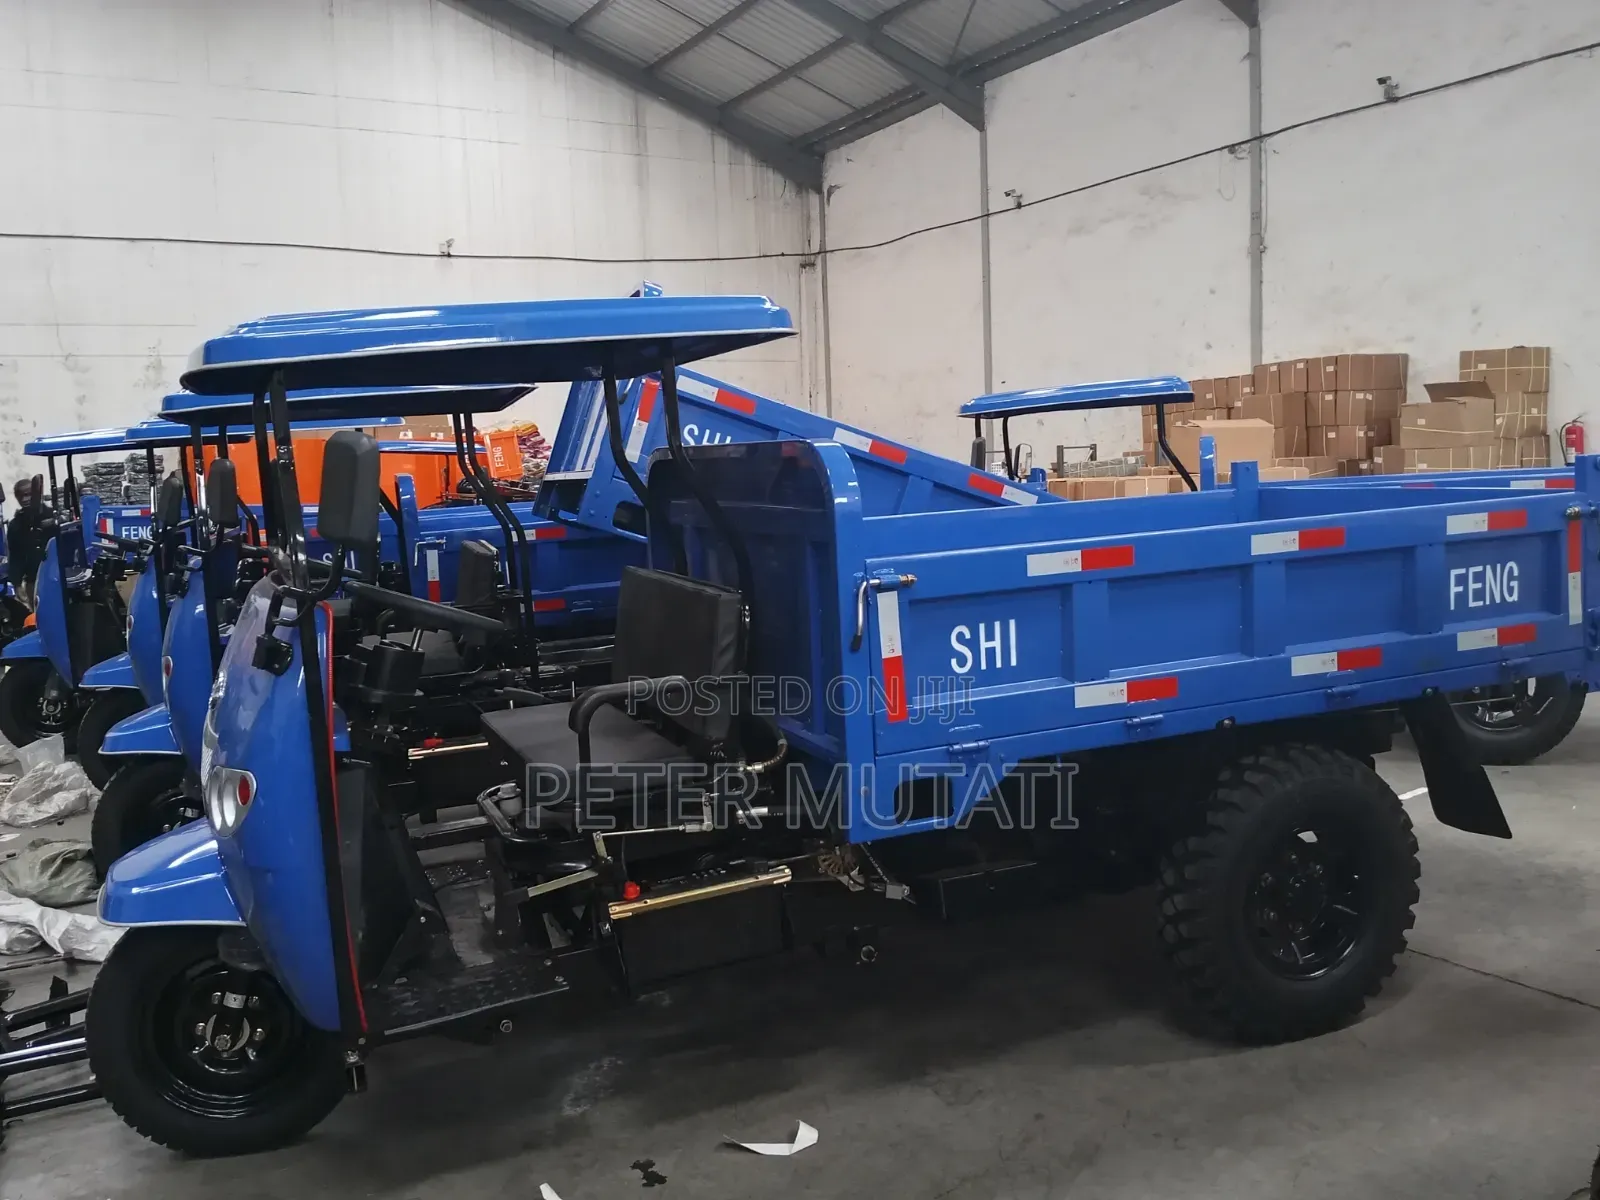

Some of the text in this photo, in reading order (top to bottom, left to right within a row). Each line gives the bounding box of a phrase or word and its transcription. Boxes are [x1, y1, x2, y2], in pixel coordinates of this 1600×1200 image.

[492, 446, 505, 468] FENG
[950, 561, 1519, 674] SHI FENG
